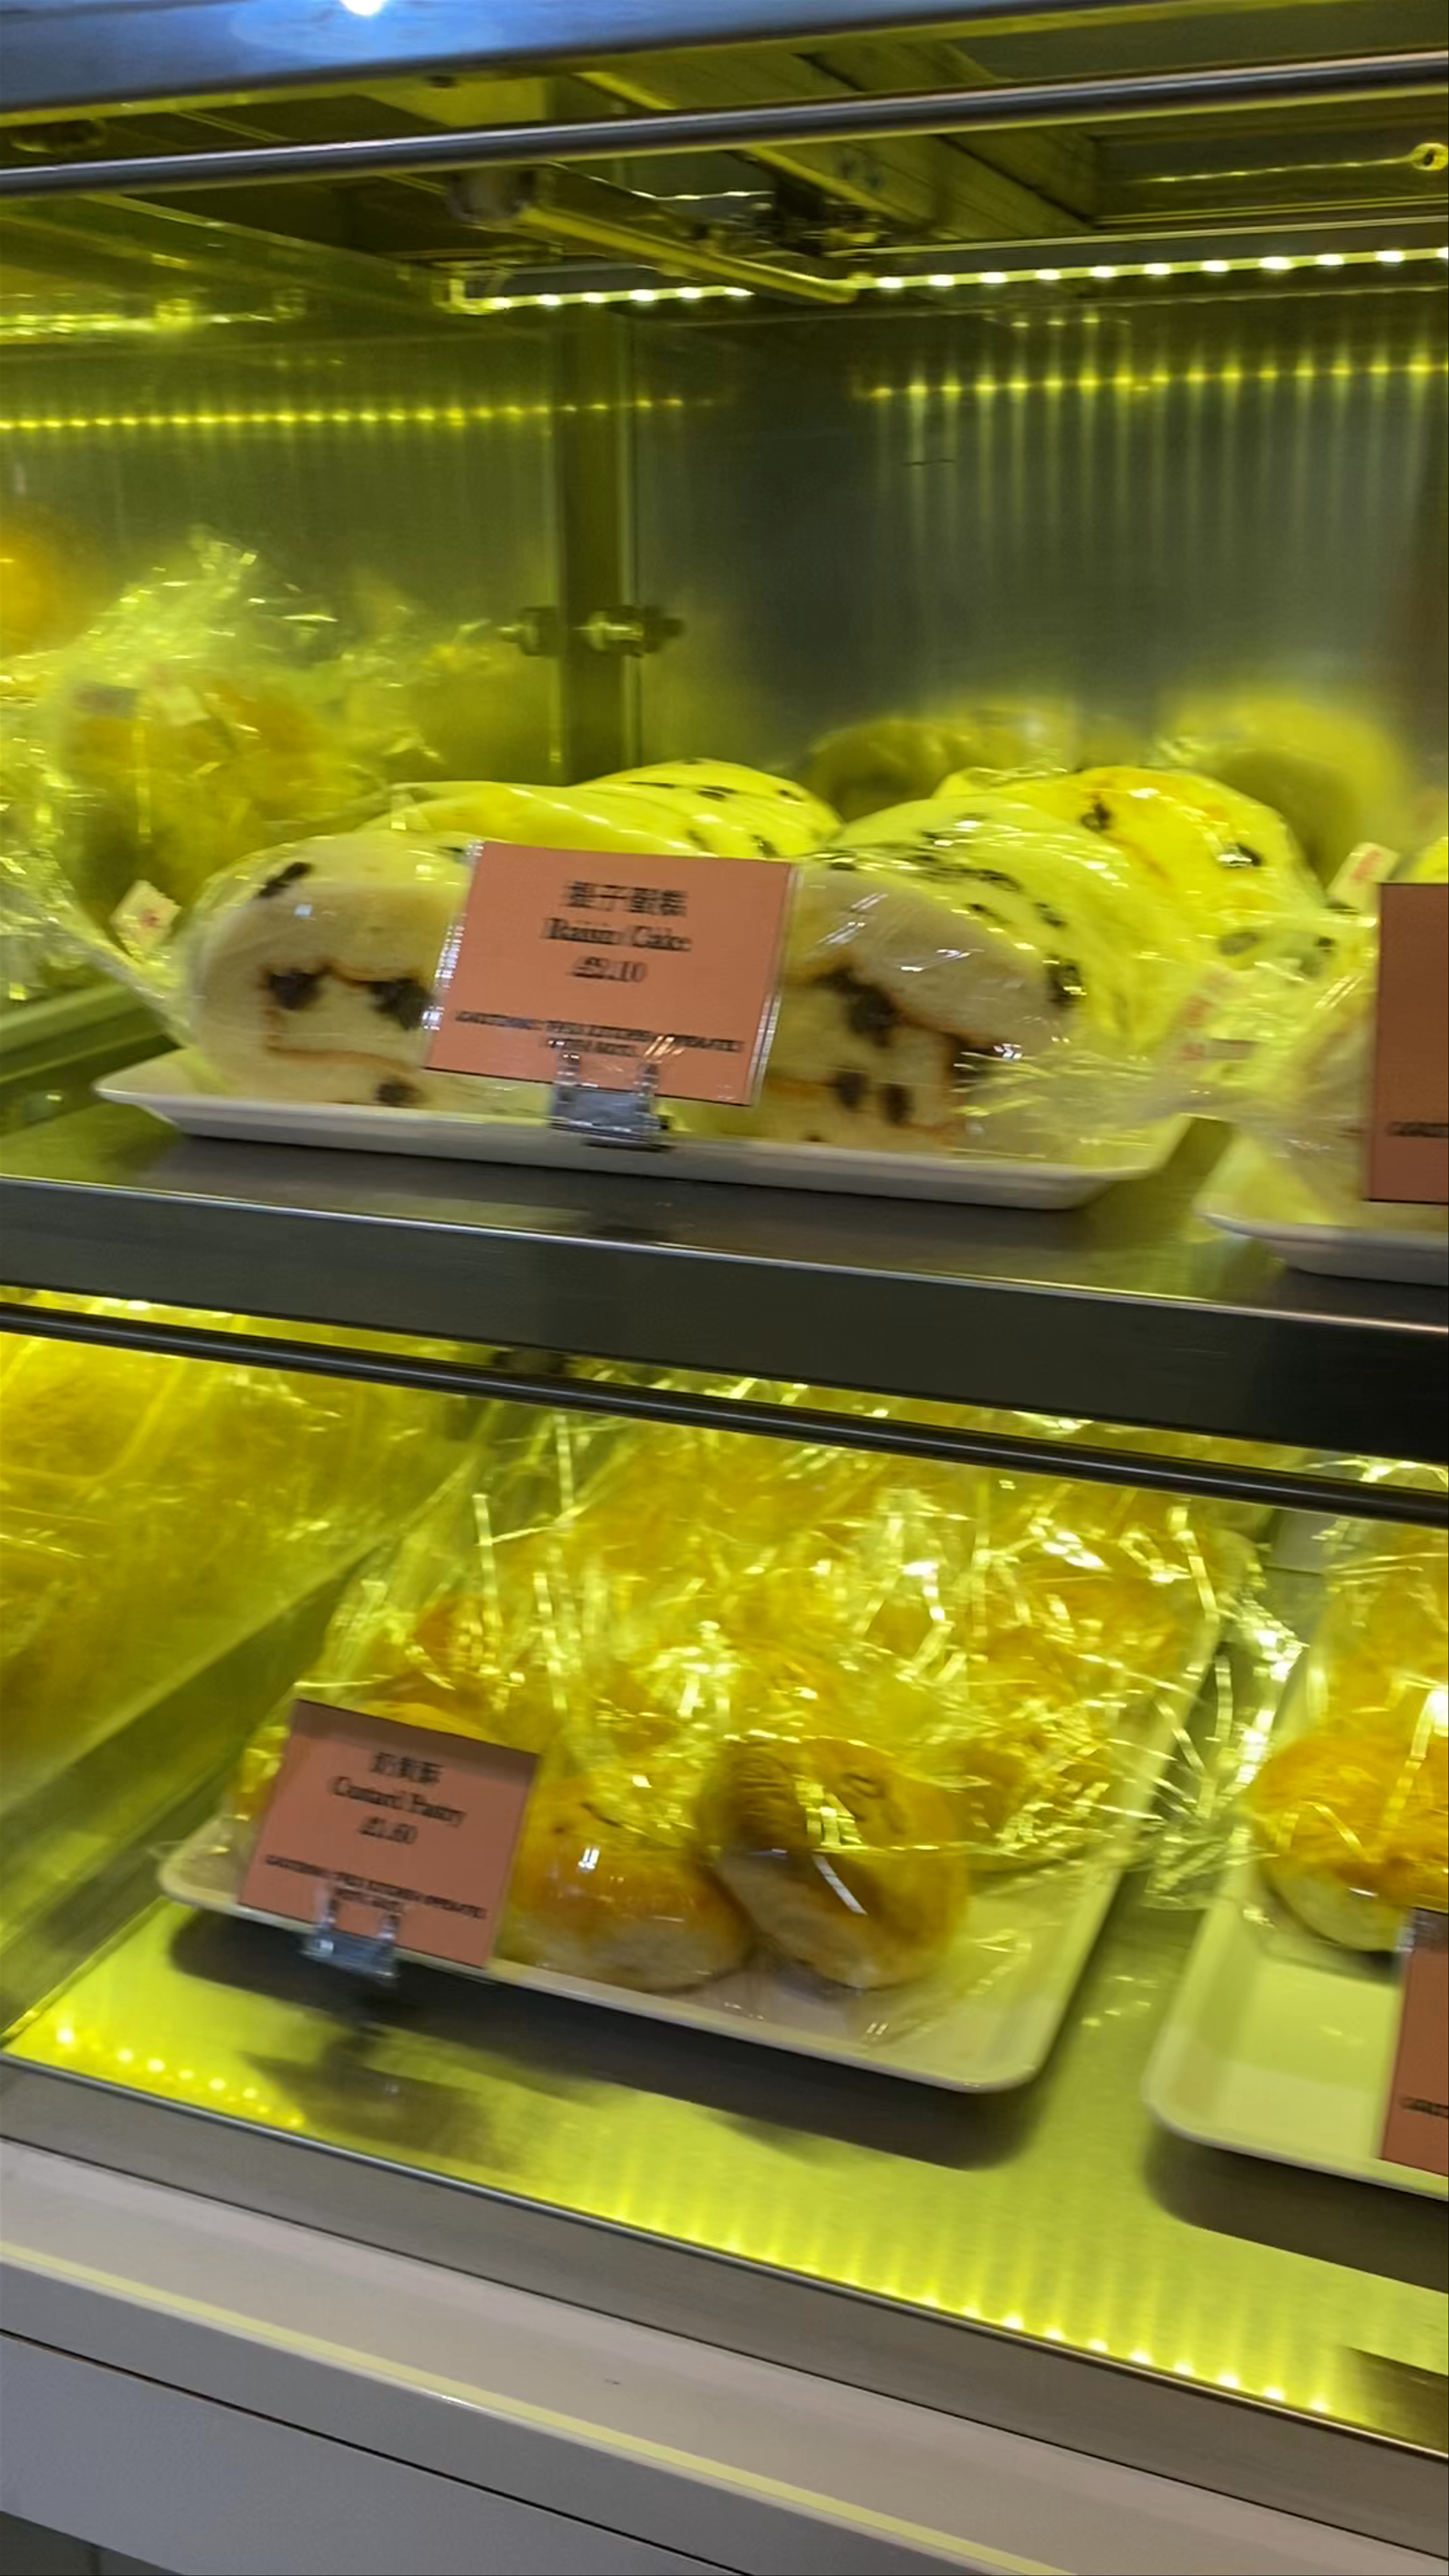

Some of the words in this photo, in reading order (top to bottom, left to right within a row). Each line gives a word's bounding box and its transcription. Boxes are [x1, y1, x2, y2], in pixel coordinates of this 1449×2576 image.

[545, 917, 622, 945] Raisin
[631, 925, 691, 951] Cake
[332, 1775, 403, 1809] Custard
[407, 1793, 466, 1827] Pastry
